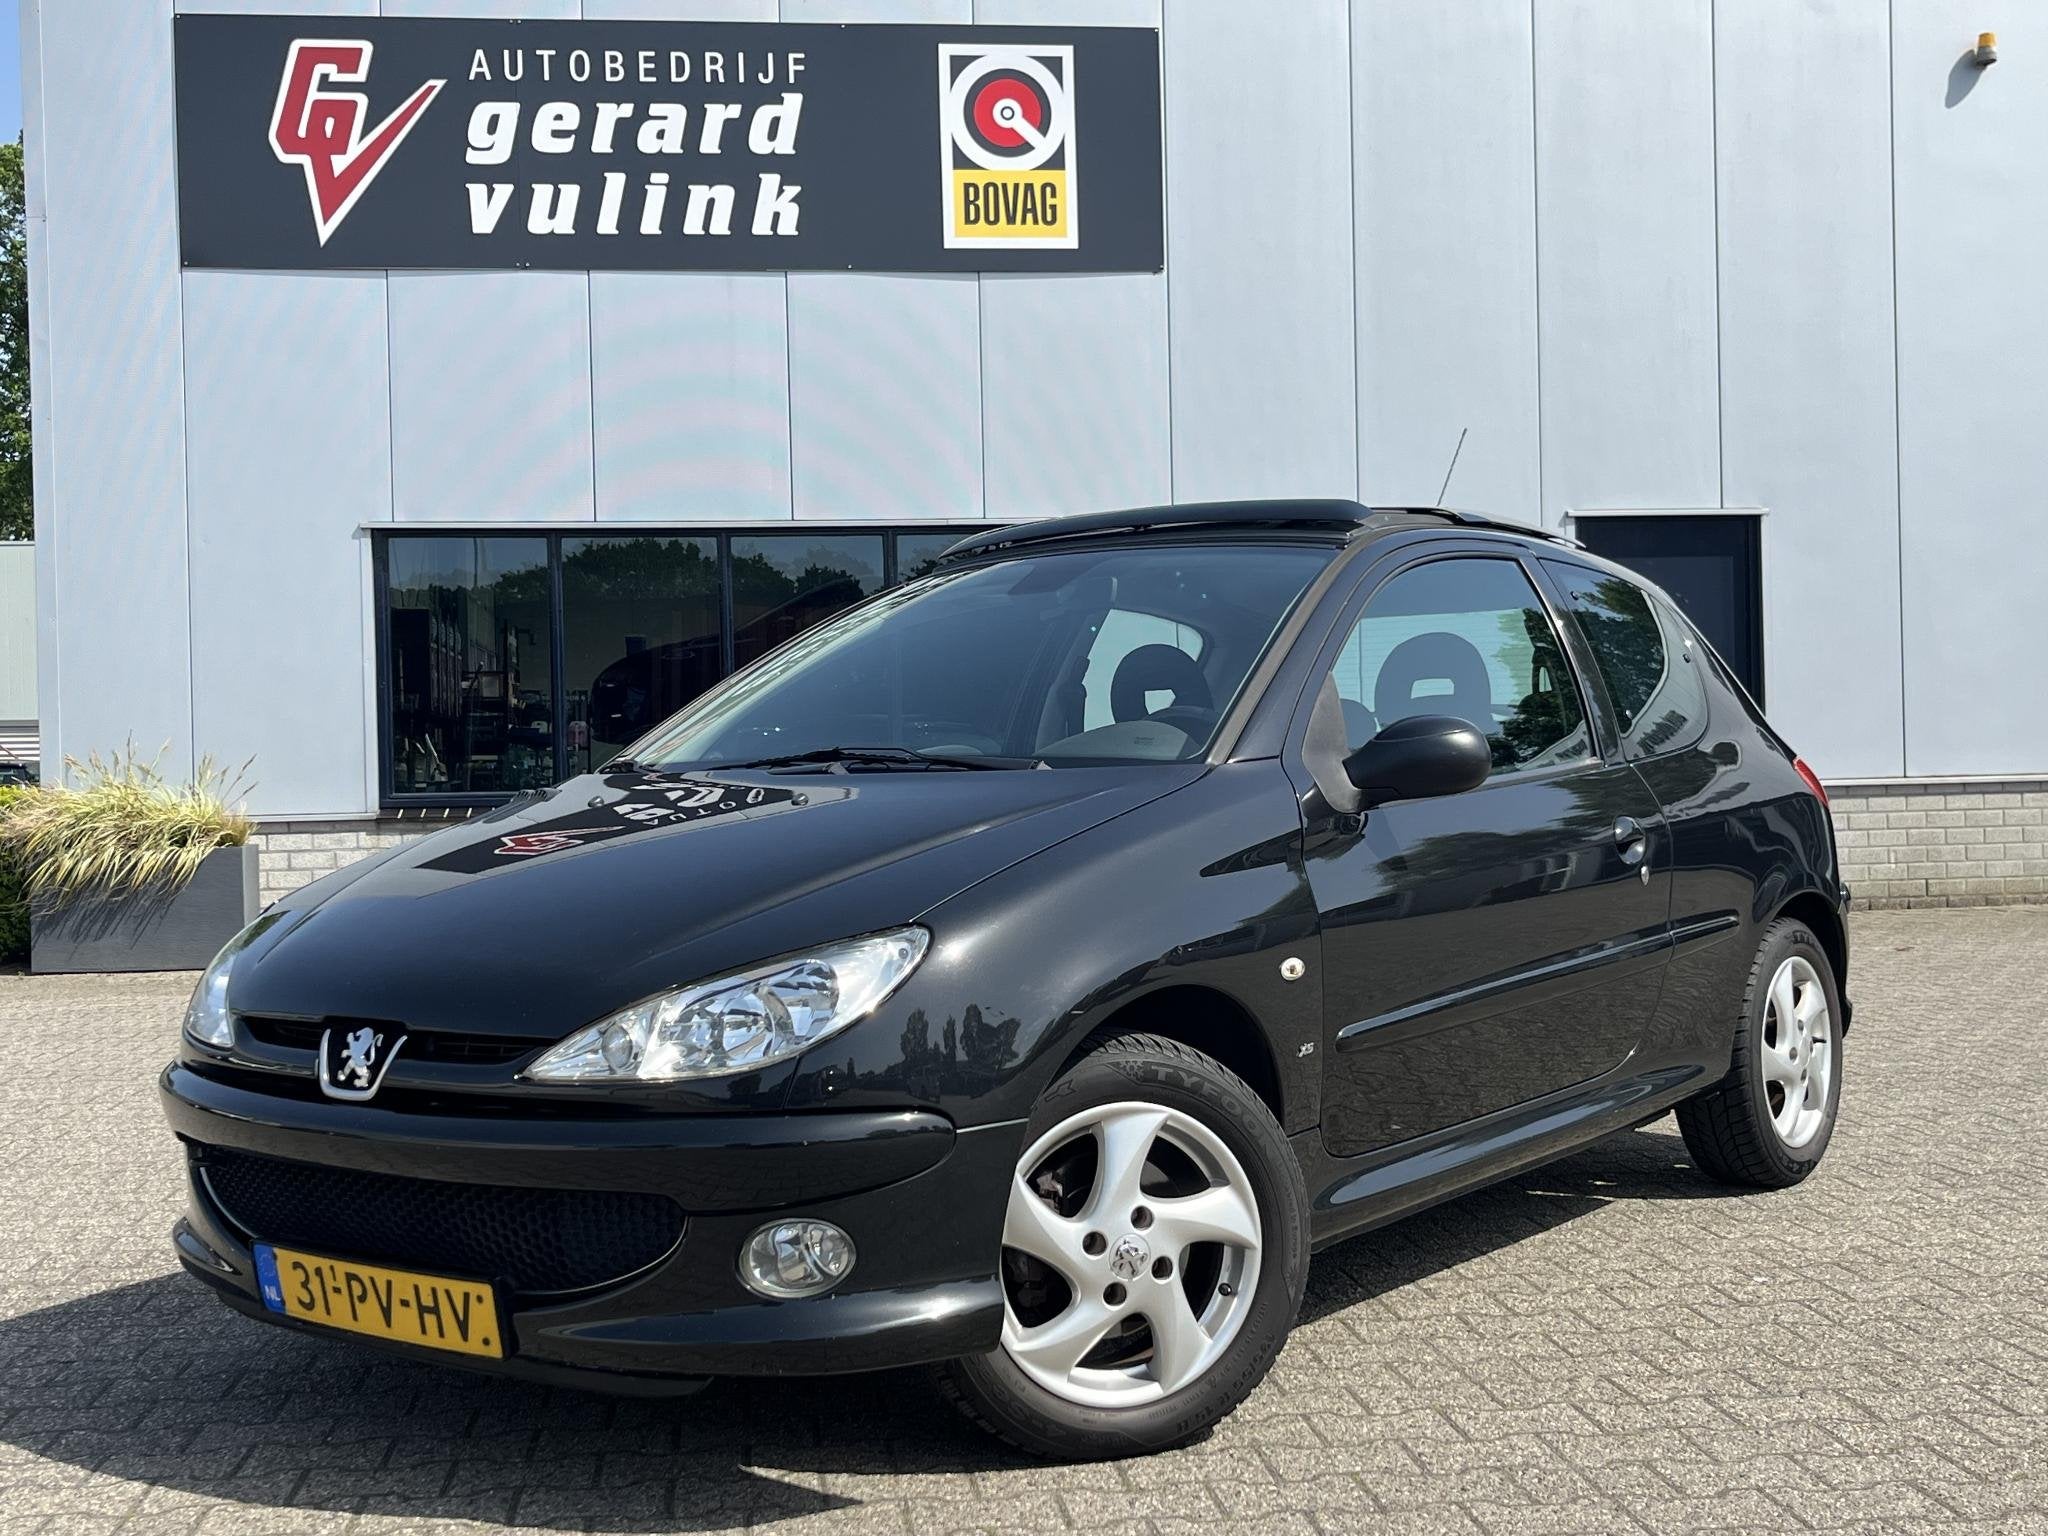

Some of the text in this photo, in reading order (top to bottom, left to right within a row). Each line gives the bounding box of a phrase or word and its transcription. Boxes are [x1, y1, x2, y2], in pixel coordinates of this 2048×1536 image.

[468, 48, 806, 85] AUTOBEDRIJF
[465, 92, 804, 165] gerard
[465, 171, 803, 236] vulink
[962, 181, 1058, 227] BOVAG
[264, 1285, 282, 1302] NL
